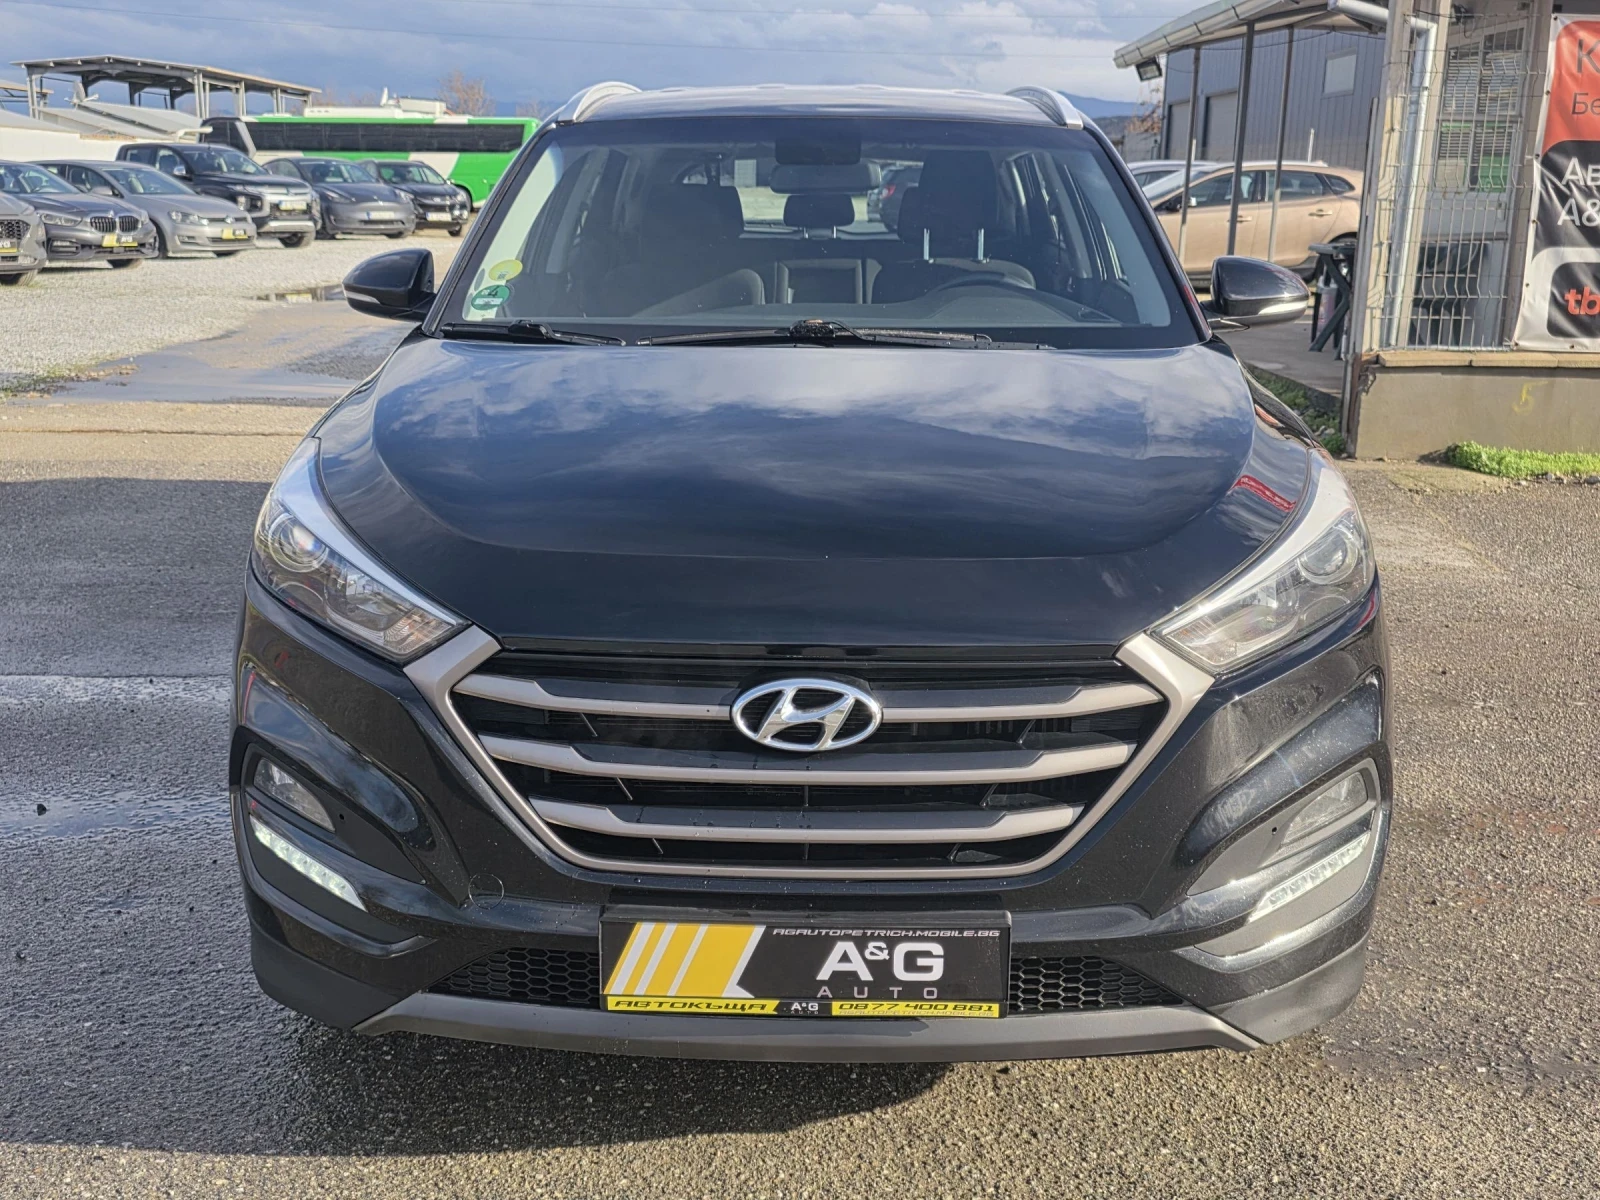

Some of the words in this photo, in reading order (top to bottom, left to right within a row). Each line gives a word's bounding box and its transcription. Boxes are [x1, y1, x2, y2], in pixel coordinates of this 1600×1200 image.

[772, 928, 1000, 937] AGAUTOPETRICH.MOBILE.BG
[816, 941, 944, 981] A&G
[817, 986, 938, 999] AUTO
[904, 1003, 949, 1011] 400
[952, 1004, 995, 1012] 881
